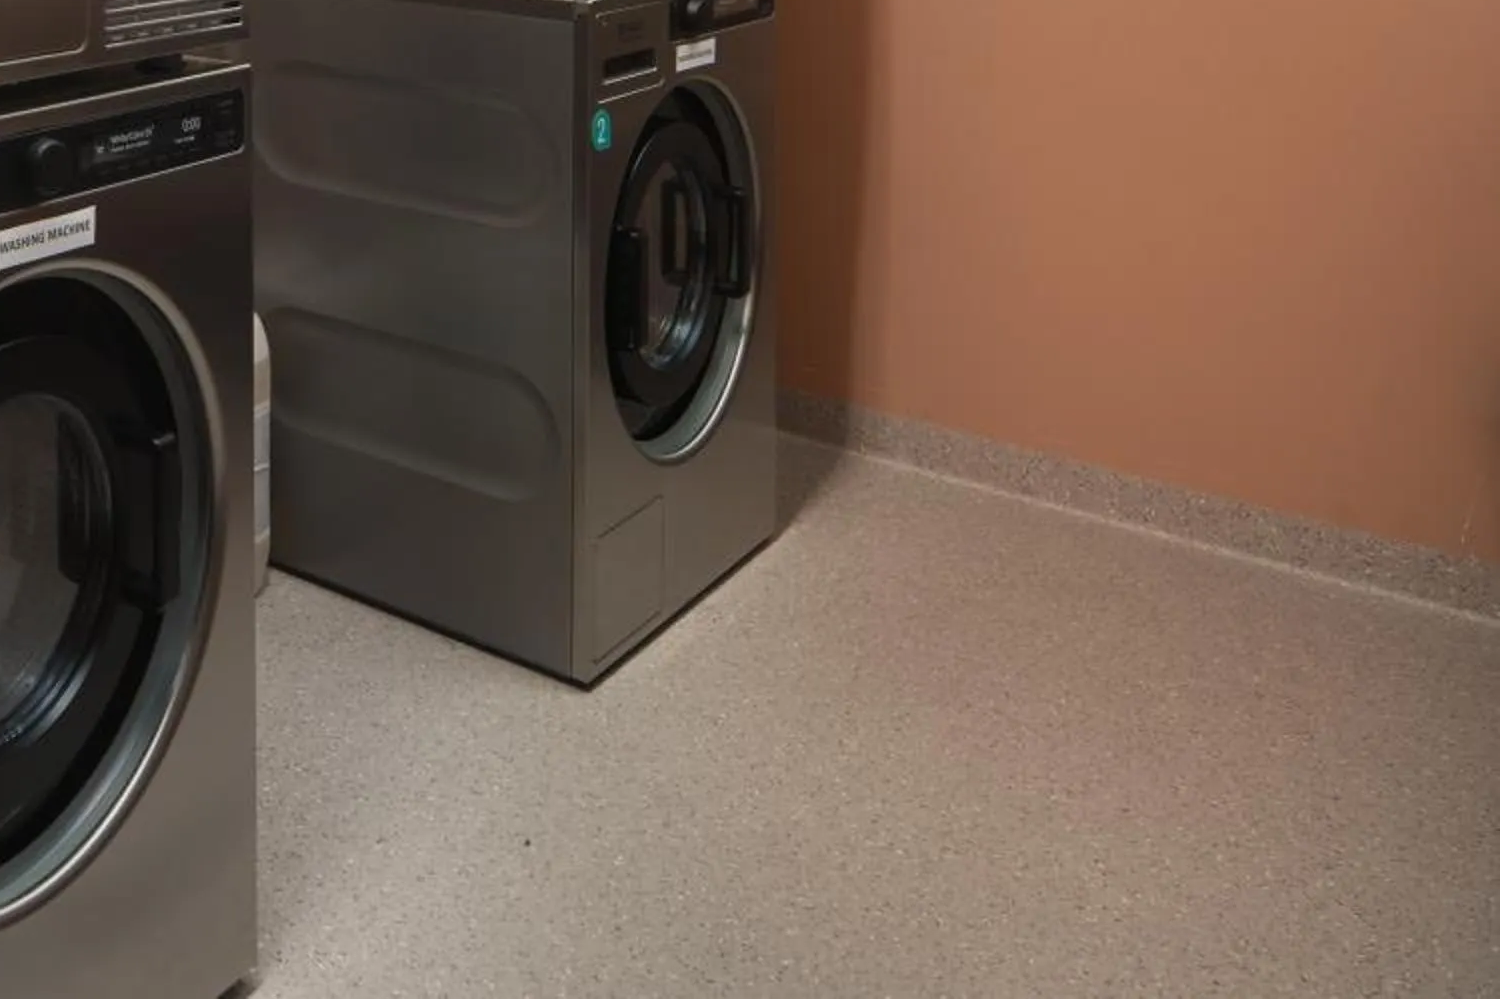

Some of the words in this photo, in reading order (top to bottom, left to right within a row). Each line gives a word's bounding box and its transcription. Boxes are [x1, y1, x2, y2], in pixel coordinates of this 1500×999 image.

[597, 117, 606, 144] 2
[0, 230, 45, 254] WASHING
[47, 219, 91, 242] MACHINE
